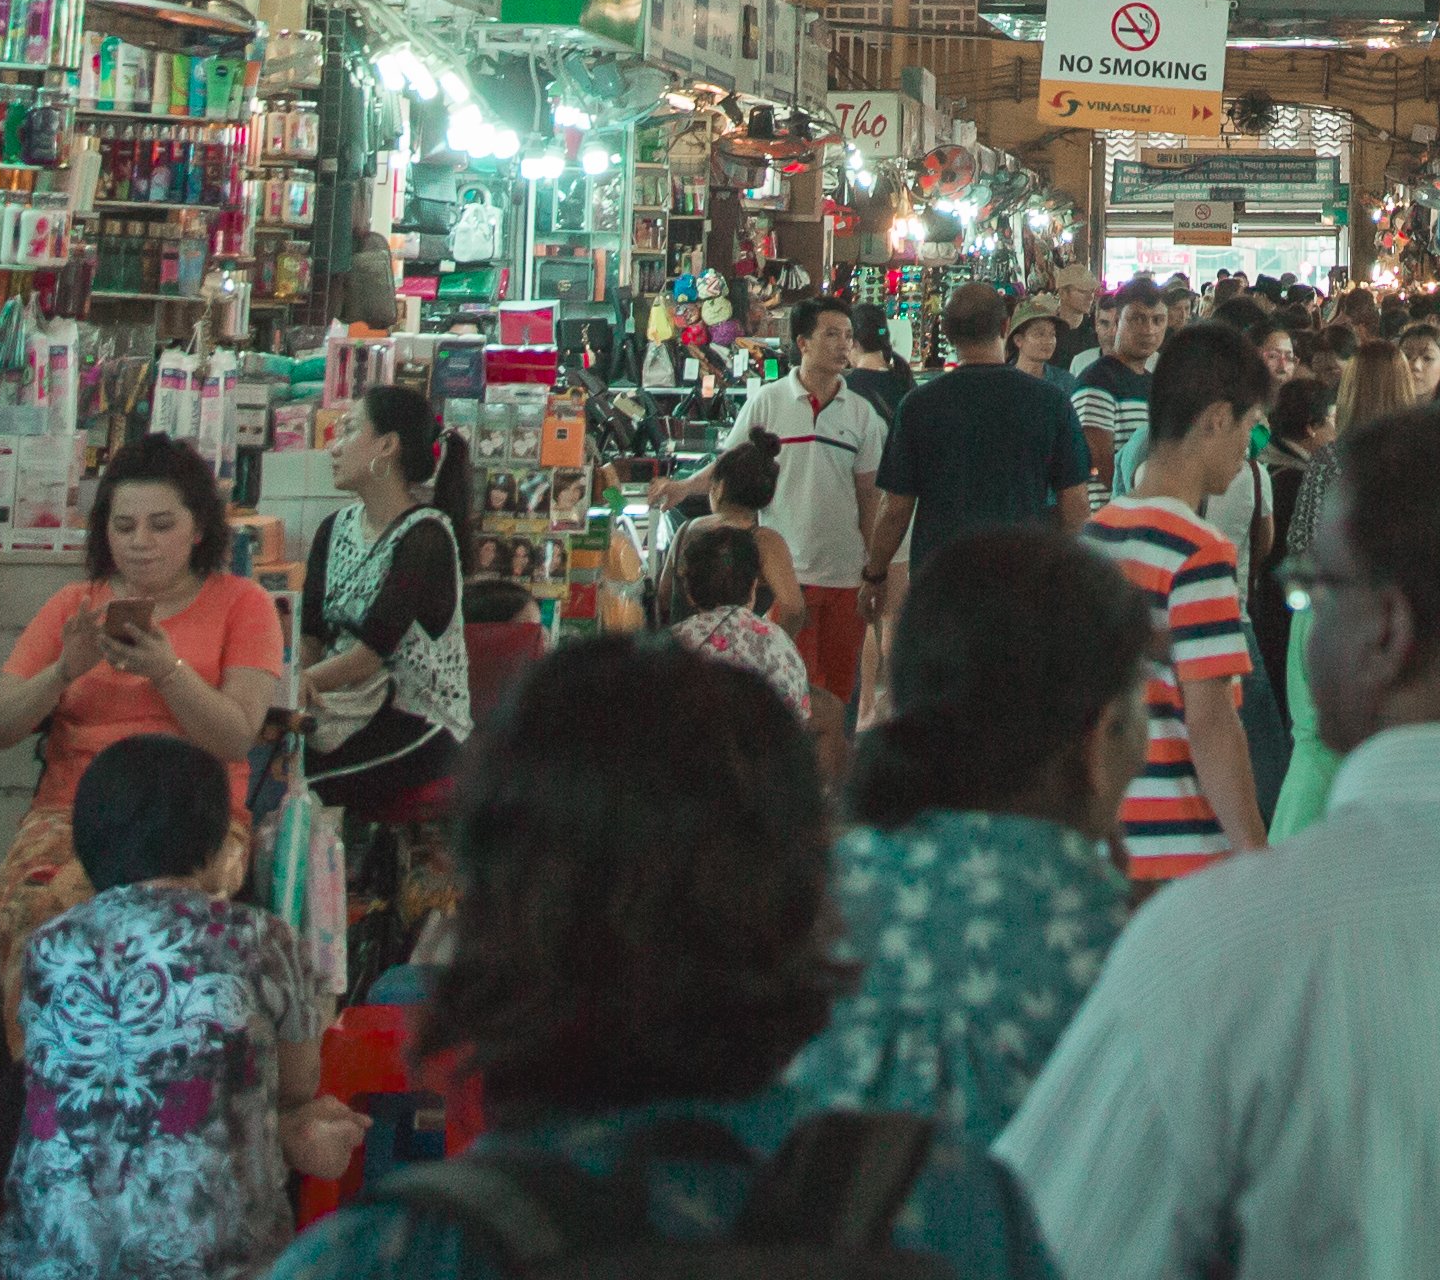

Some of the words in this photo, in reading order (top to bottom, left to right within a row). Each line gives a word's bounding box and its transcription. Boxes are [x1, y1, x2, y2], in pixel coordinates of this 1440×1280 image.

[1059, 54, 1093, 74] NO
[1098, 56, 1208, 82] SMOKING
[1177, 220, 1191, 230] NO
[1191, 220, 1229, 231] SMOKING
